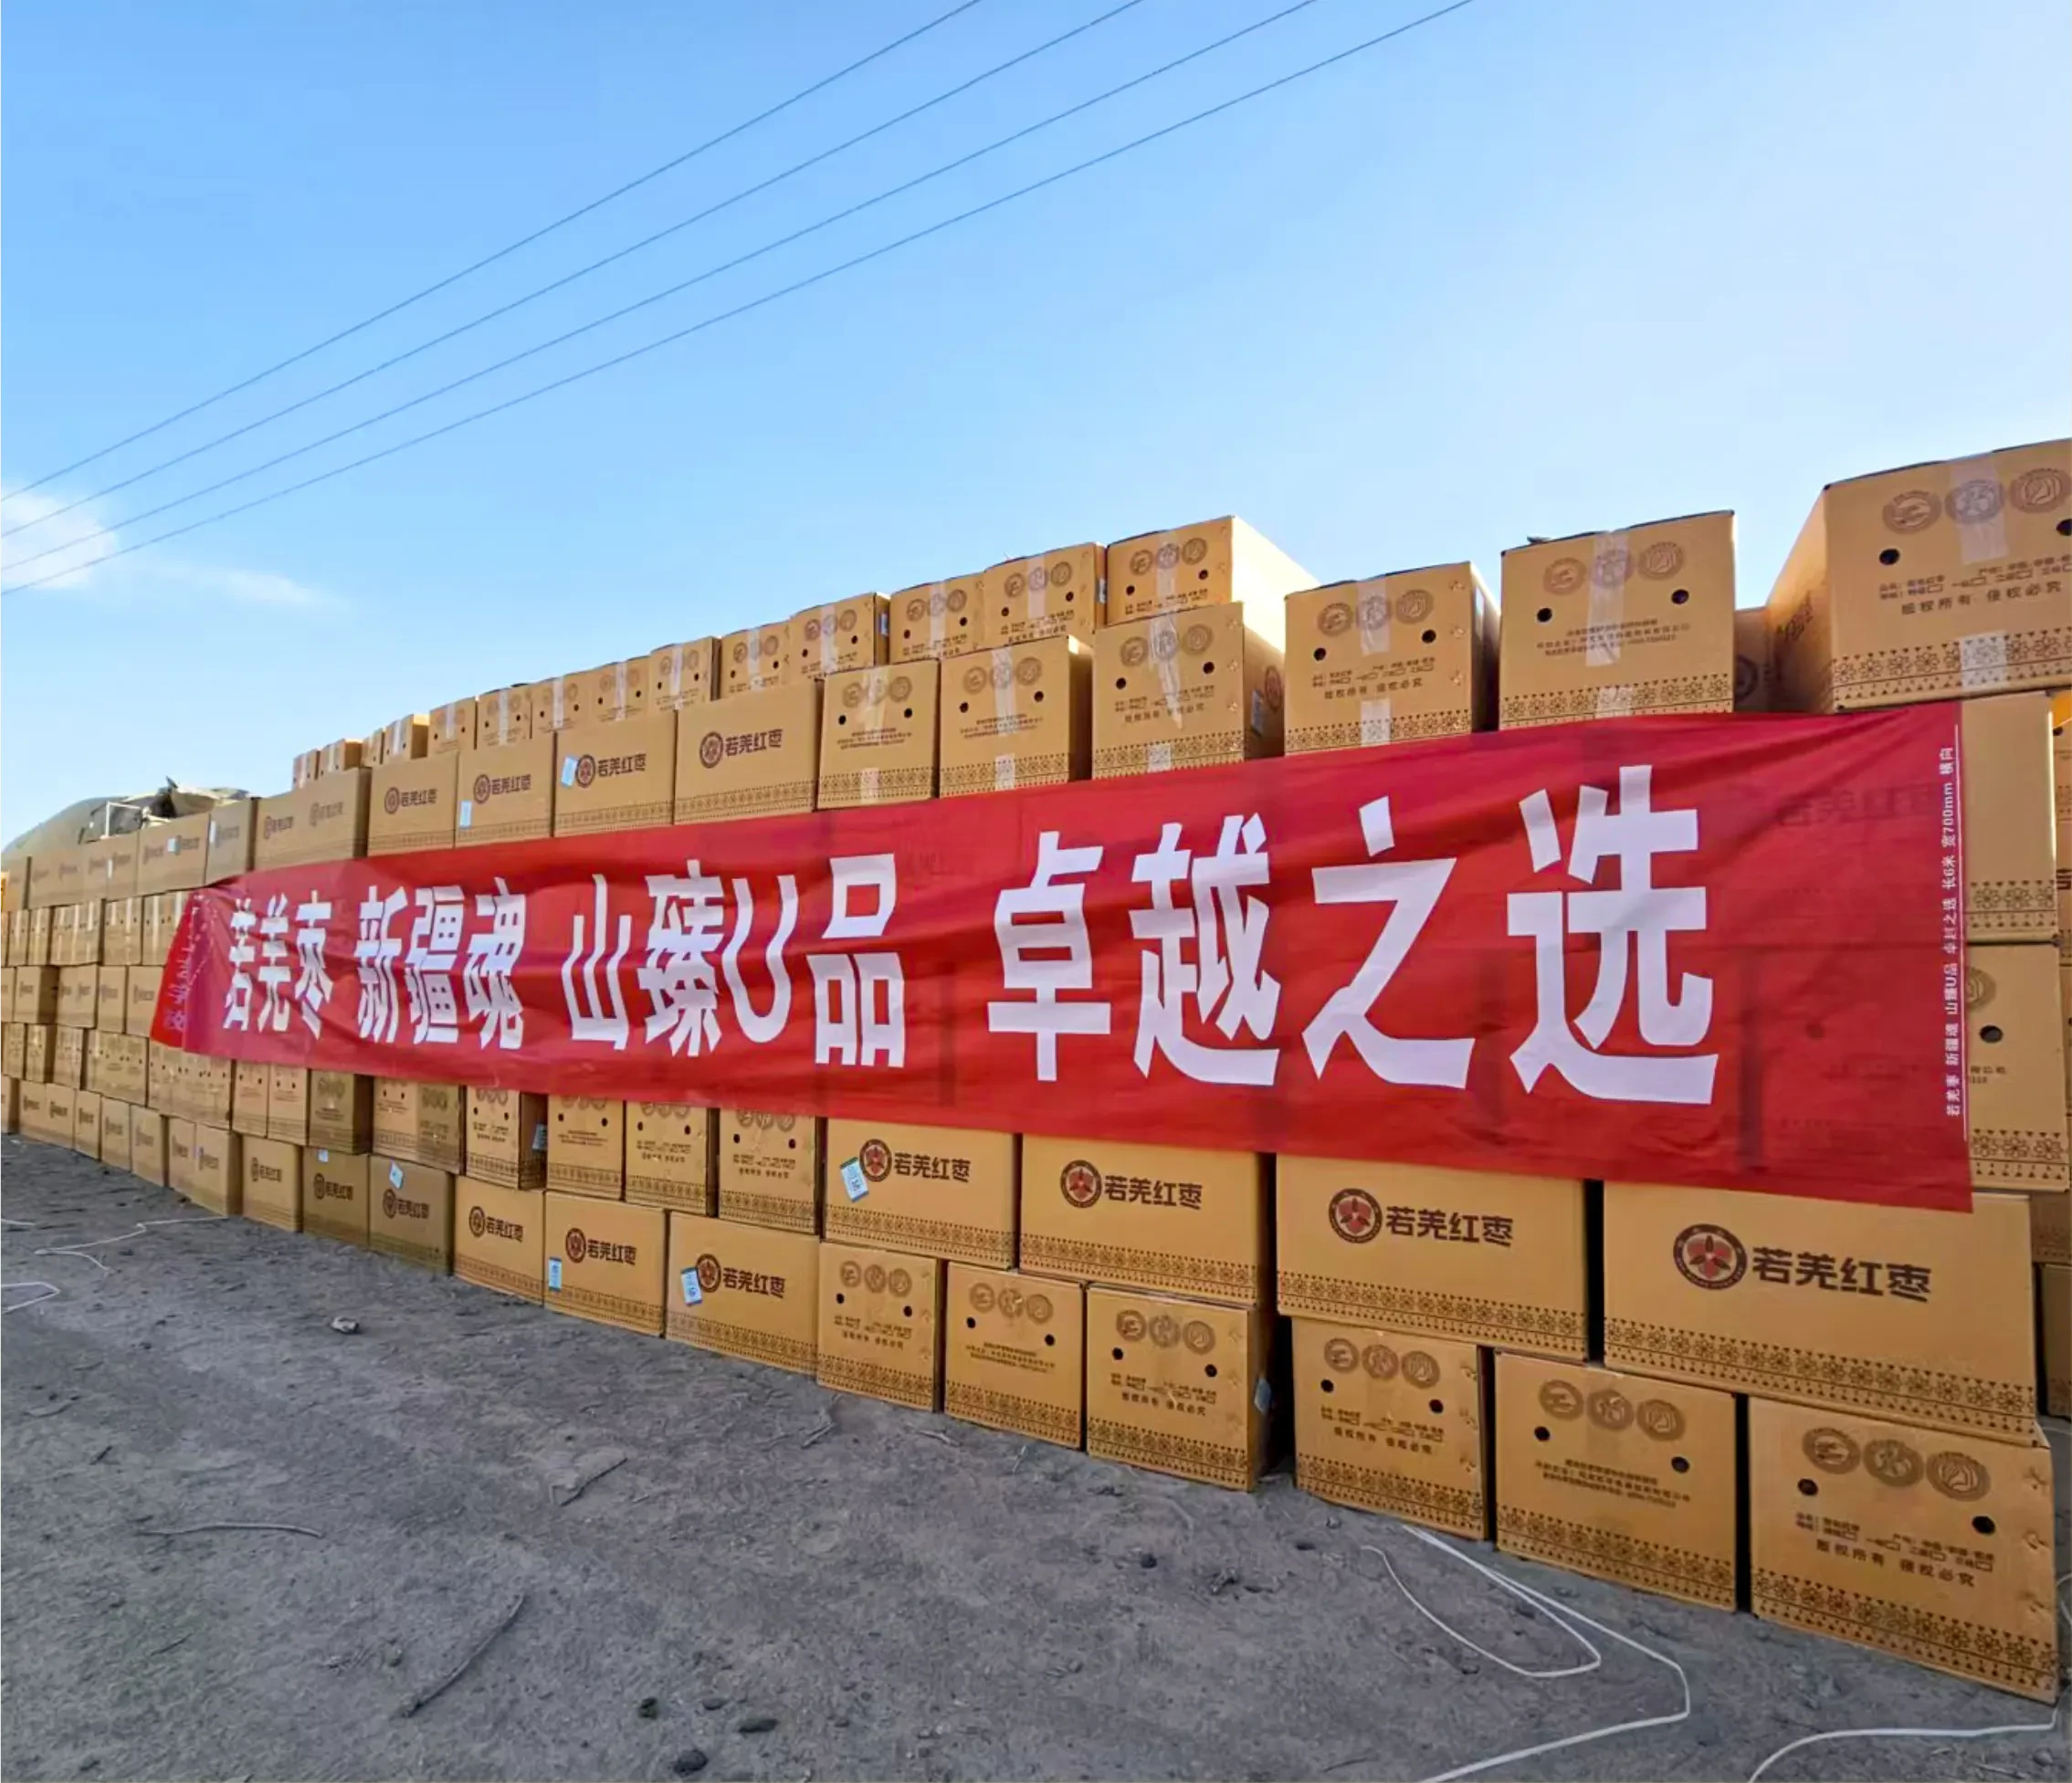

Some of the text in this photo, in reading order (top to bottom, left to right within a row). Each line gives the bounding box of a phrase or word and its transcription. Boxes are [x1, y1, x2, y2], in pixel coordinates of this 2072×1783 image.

[725, 729, 783, 760] 若羌红枣
[596, 752, 647, 779] 若羌红枣
[353, 877, 526, 1050] 新疆魂
[561, 854, 905, 1067] 山臻U品
[988, 764, 1719, 1105] 卓越之选
[894, 1152, 971, 1184] 若羌红枣
[1104, 1174, 1204, 1211] 若羌红枣
[1385, 1205, 1514, 1249] 若羌红枣
[586, 1238, 636, 1266] 若羌红枣
[722, 1267, 785, 1299] 若羌红枣
[1751, 1246, 1933, 1304] 若羌红枣
